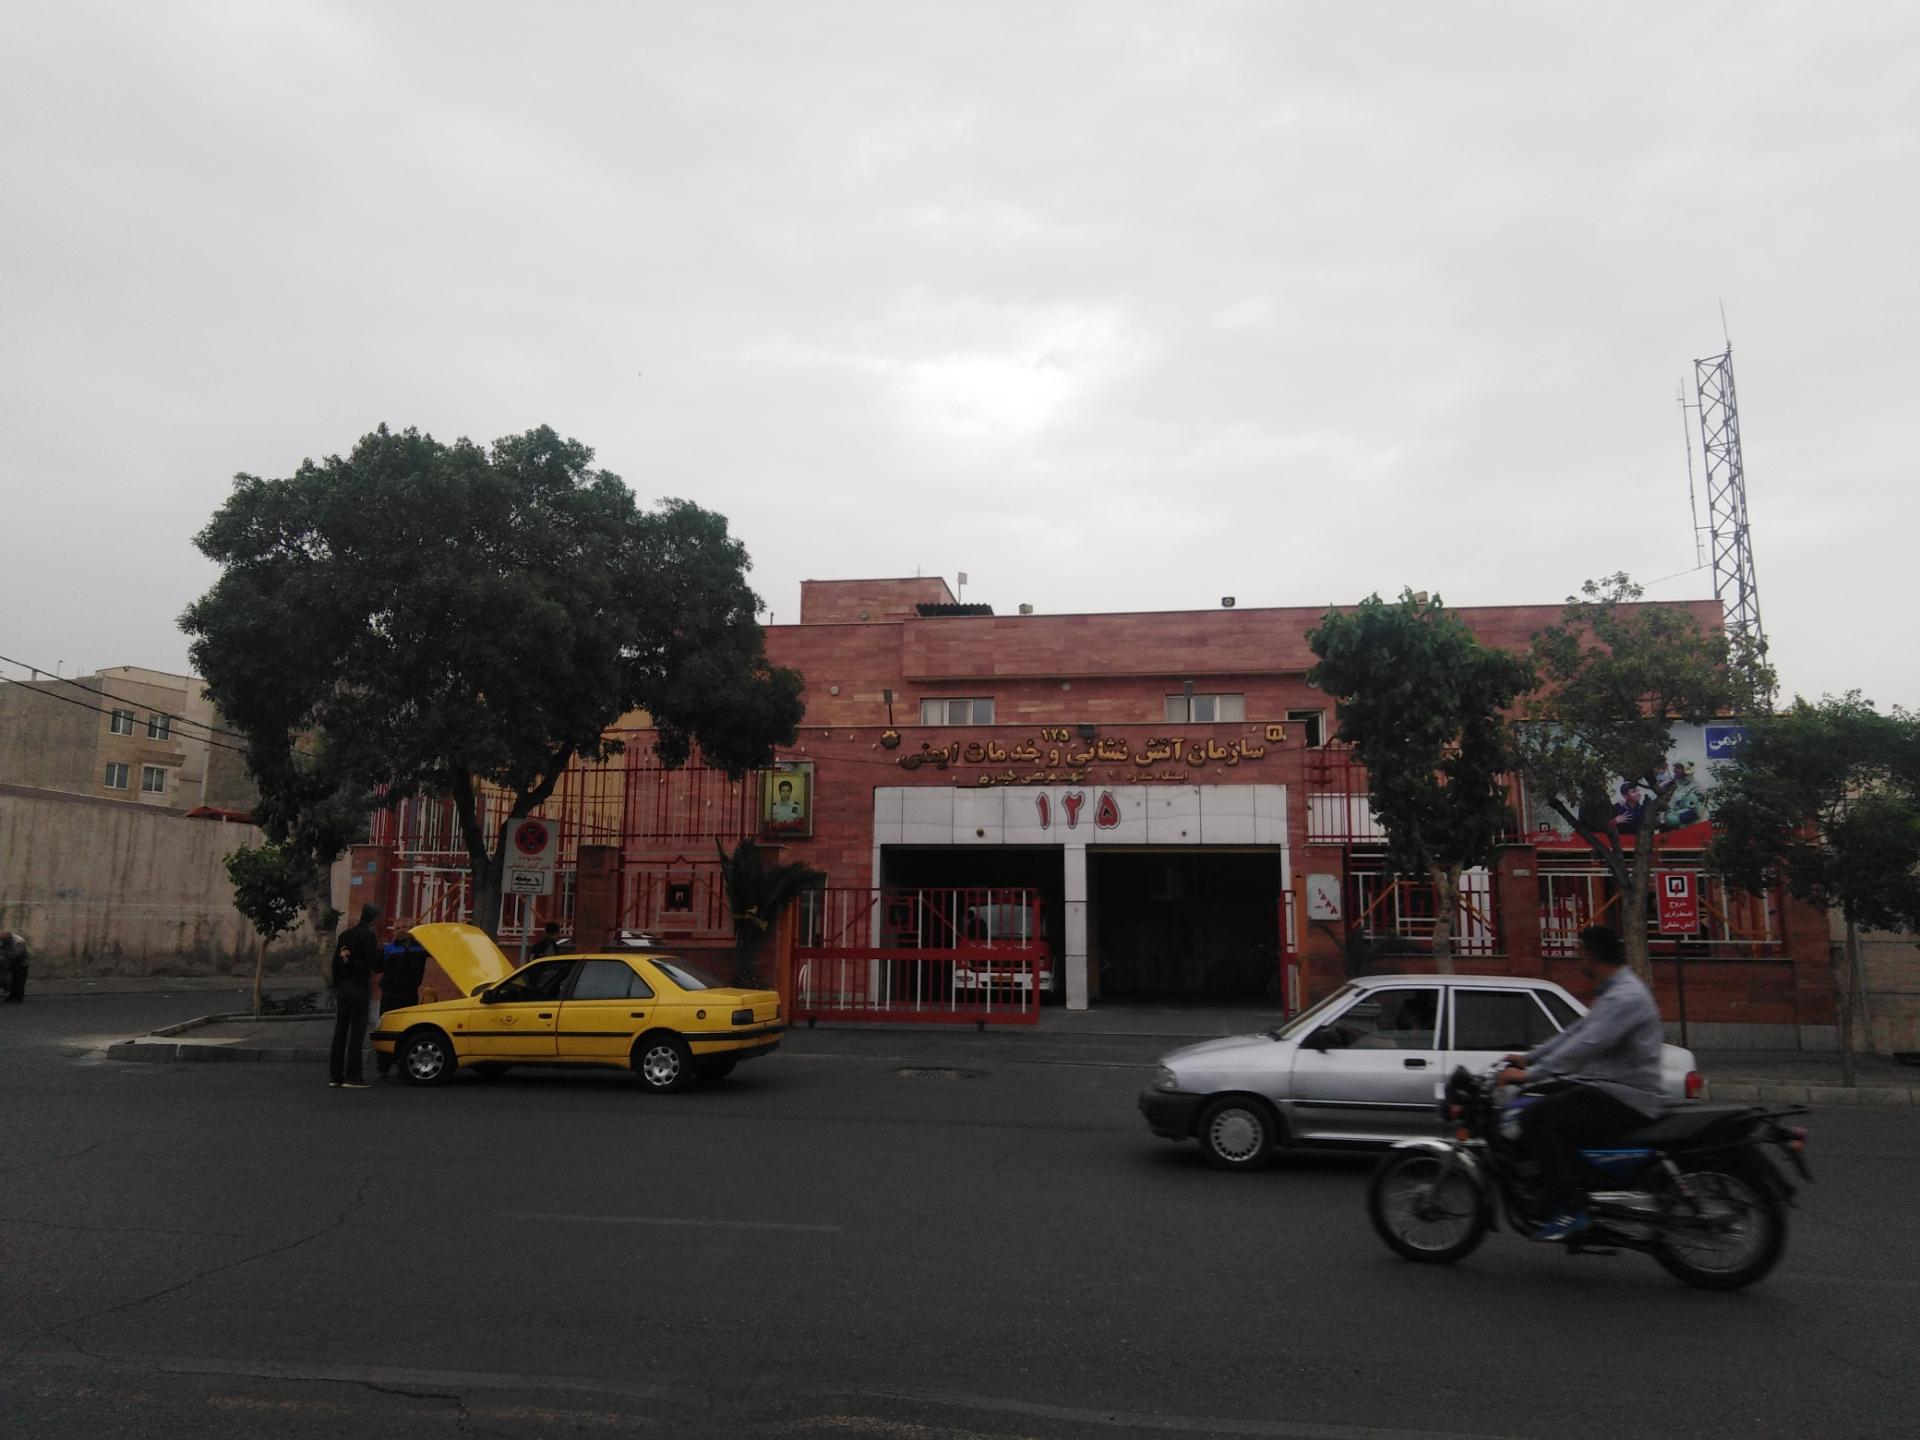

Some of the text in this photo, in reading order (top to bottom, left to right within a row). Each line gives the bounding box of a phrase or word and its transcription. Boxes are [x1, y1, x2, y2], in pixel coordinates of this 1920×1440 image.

[1041, 728, 1070, 743] ۱۲۵
[899, 736, 1266, 769] سازمان آتش نشانی و خدمات ایمنی
[1020, 769, 1056, 784] مرتضی
[1156, 769, 1188, 784] ایستگاه
[1035, 790, 1121, 830] ۱۲۵
